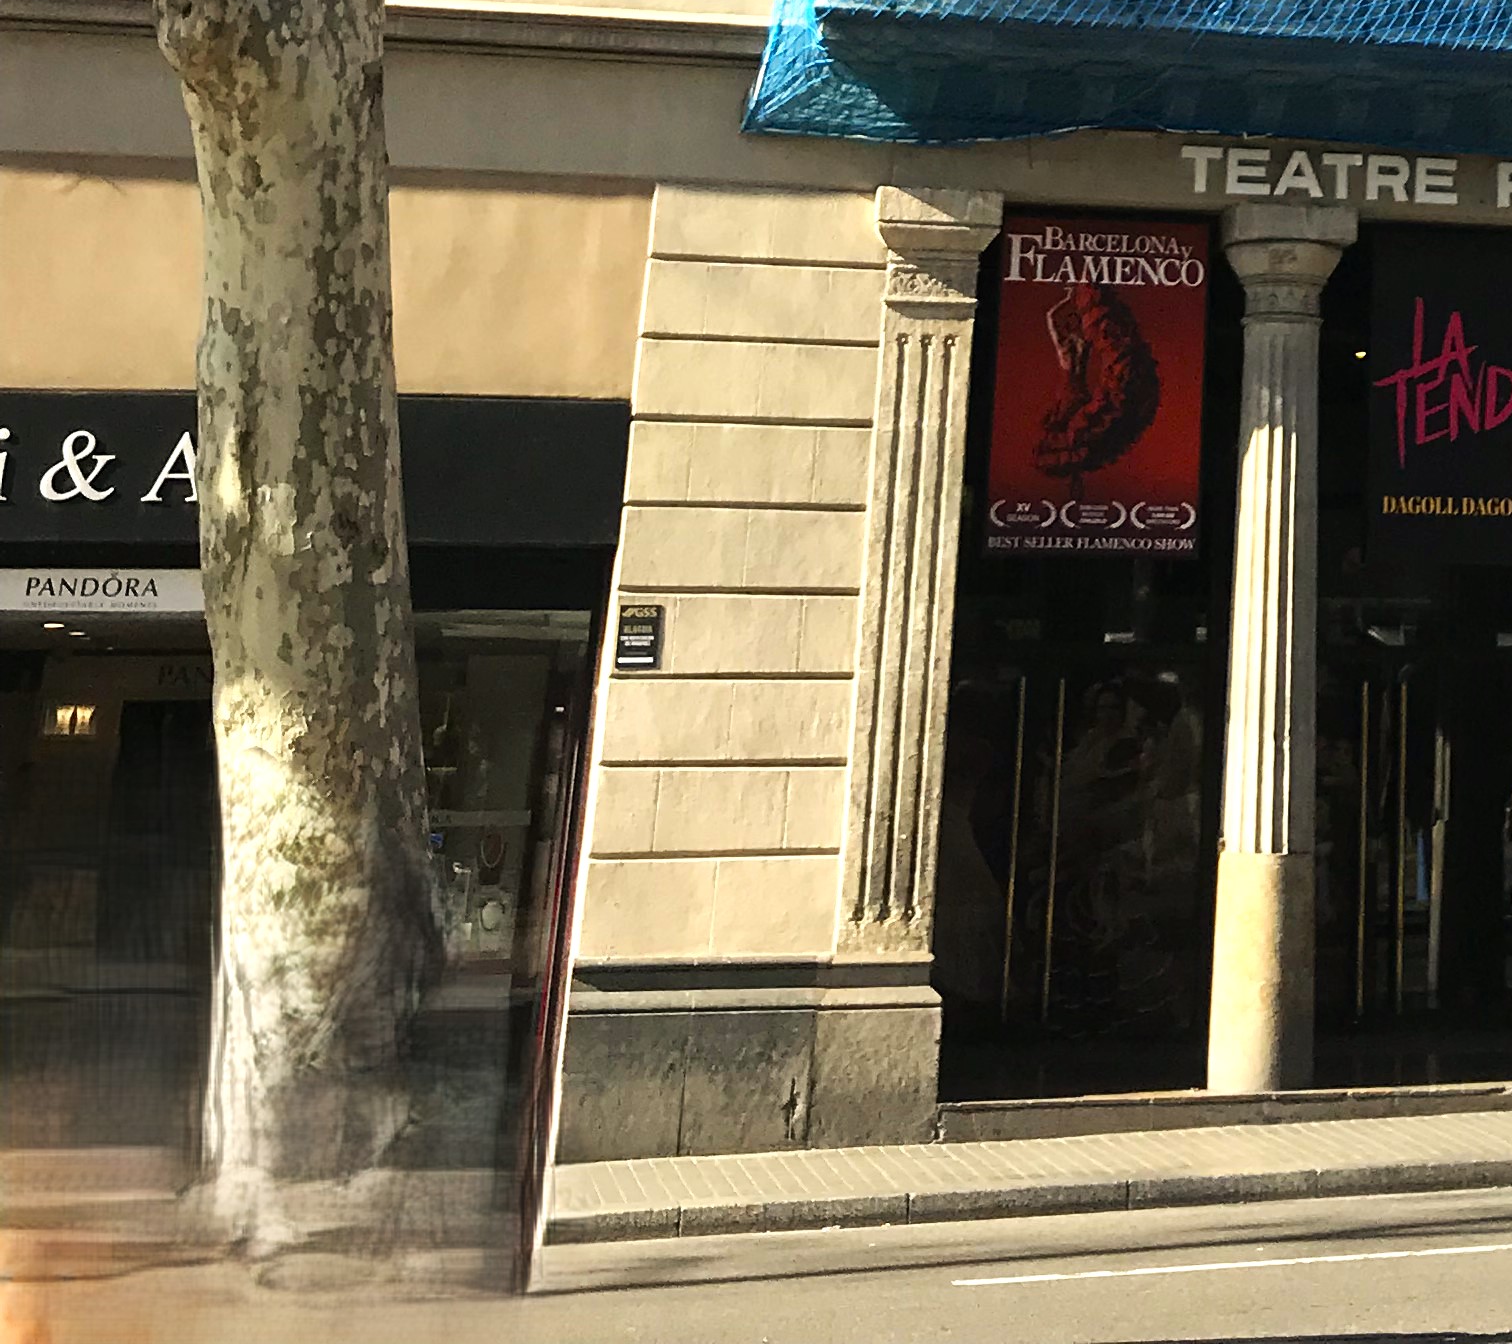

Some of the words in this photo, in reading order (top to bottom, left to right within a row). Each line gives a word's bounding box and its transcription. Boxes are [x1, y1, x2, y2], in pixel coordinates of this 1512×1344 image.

[1180, 146, 1459, 205] TEATRE
[1003, 233, 1205, 287] FLAMENCO
[1044, 225, 1179, 254] BARCELONA
[1411, 296, 1479, 391] LA
[39, 430, 116, 501] &
[1382, 495, 1459, 515] DAGOLL
[986, 536, 1021, 549] BEST
[1023, 536, 1074, 549] SELLER
[1076, 537, 1152, 550] FLAMENCO
[1153, 538, 1196, 551] SHOW
[25, 575, 159, 598] PANDORA
